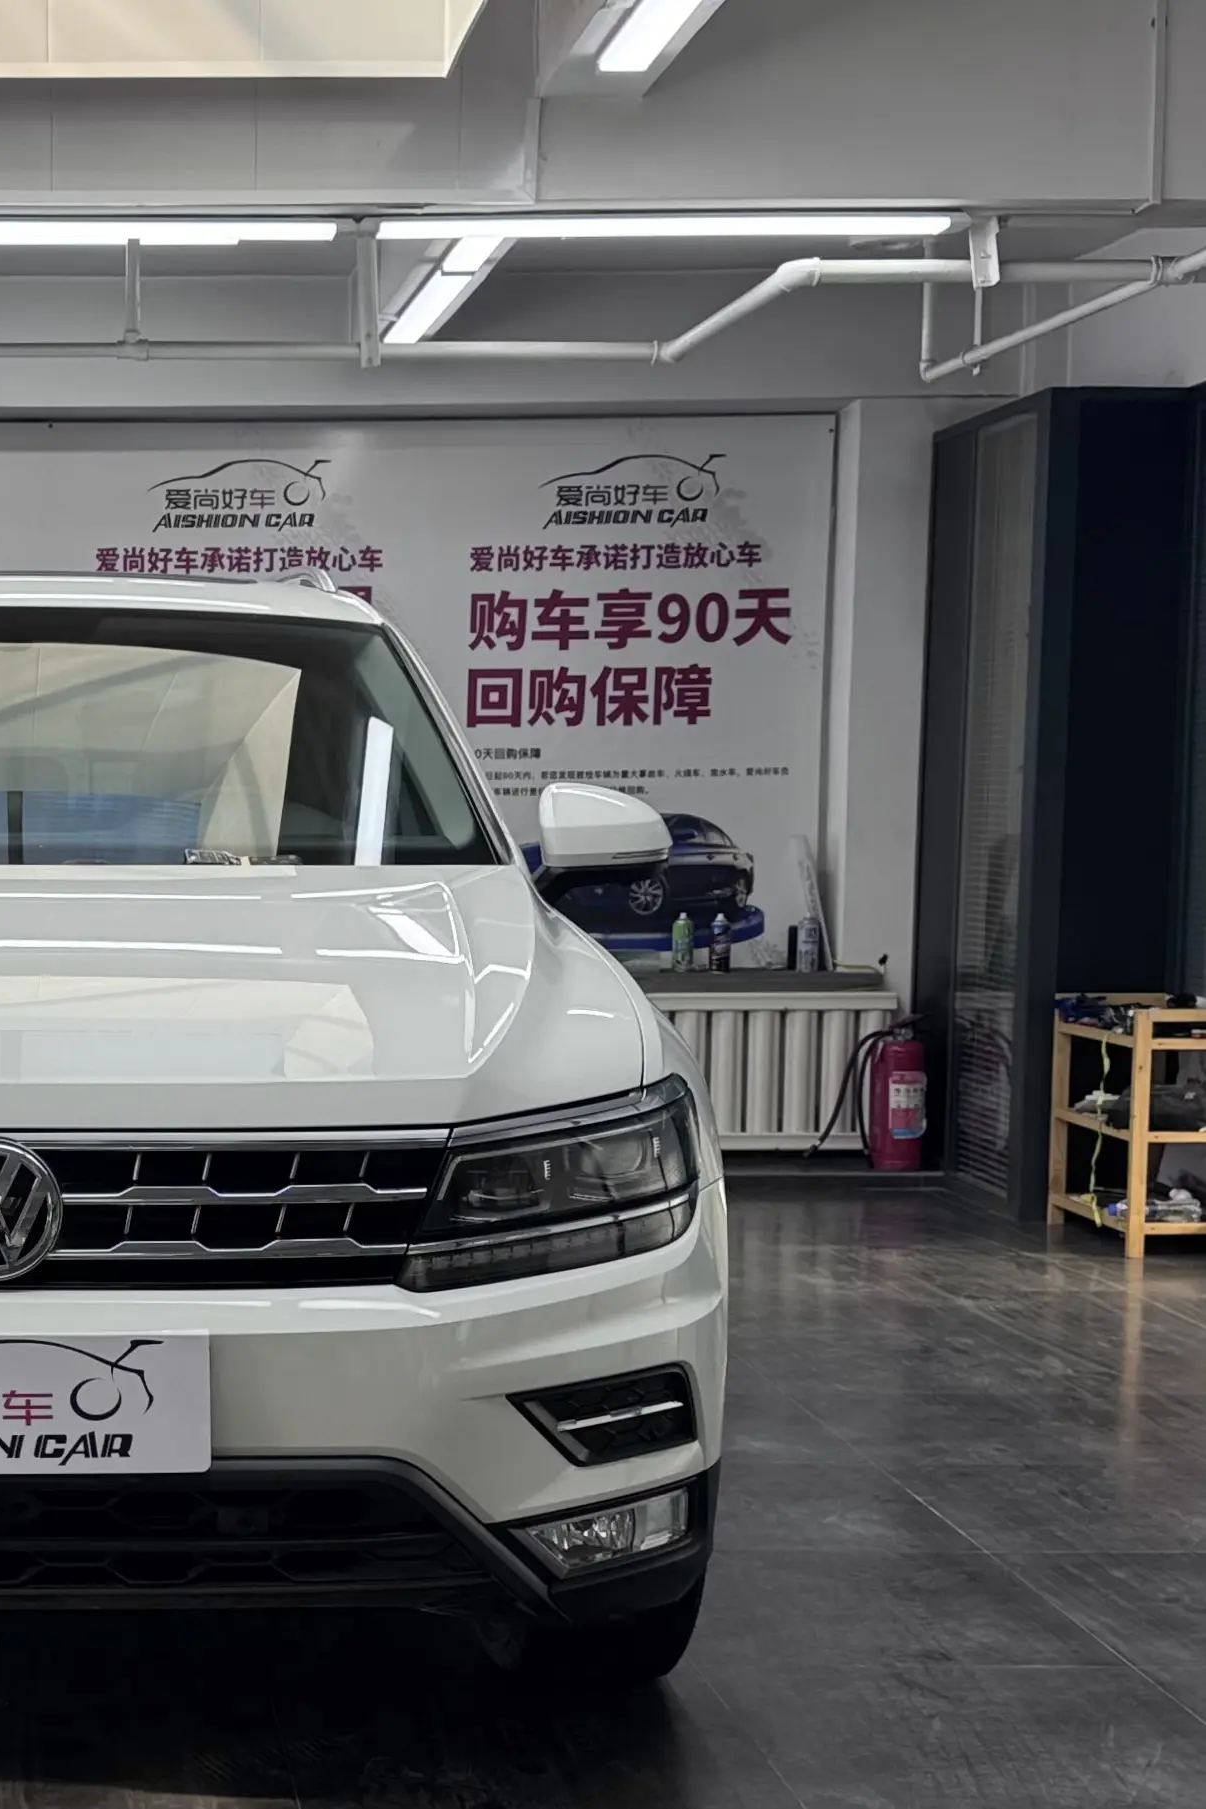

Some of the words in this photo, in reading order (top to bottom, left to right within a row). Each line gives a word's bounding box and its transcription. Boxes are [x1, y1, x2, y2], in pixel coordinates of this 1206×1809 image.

[165, 488, 275, 509] 爱尚好车
[556, 484, 668, 507] 爱尚好车
[152, 513, 261, 532] AISHION
[265, 513, 315, 532] CAR
[543, 509, 653, 529] AISHION
[657, 507, 708, 528] CAR
[95, 546, 383, 574] 爱尚好车承诺打造放心车
[469, 541, 762, 572] 爱尚好车承诺打造放心车
[468, 587, 792, 652] 购车享90天
[466, 663, 712, 728] 回购保障
[475, 748, 542, 760] 0天回购保障
[33, 1430, 133, 1466] CAR
